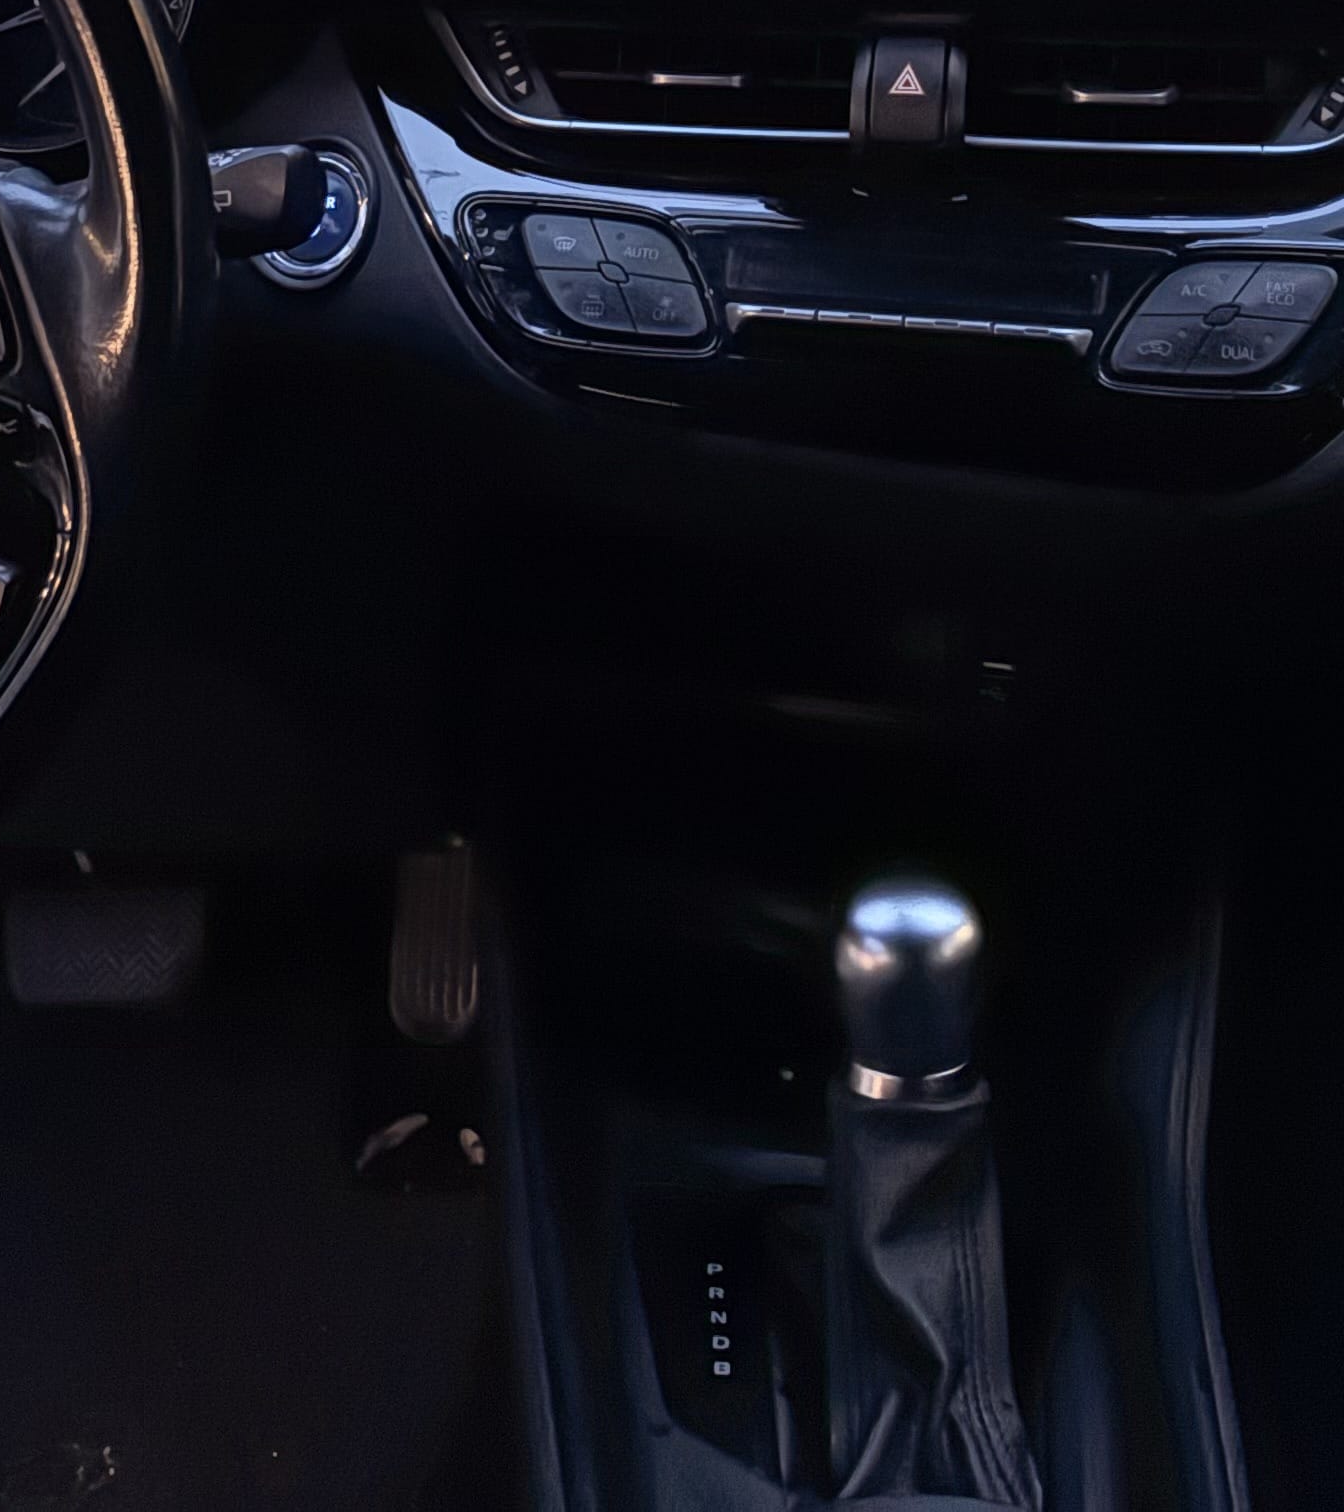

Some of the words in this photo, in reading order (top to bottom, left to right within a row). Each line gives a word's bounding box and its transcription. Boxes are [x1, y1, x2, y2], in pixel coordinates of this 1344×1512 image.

[623, 246, 660, 261] AUTO
[1180, 283, 1207, 298] A/C
[1265, 280, 1297, 294] FAST
[652, 308, 677, 322] OFF
[1220, 344, 1257, 361] DUAL
[706, 1263, 724, 1276] P
[708, 1286, 725, 1300] R
[710, 1310, 727, 1324] N
[712, 1335, 730, 1350] D
